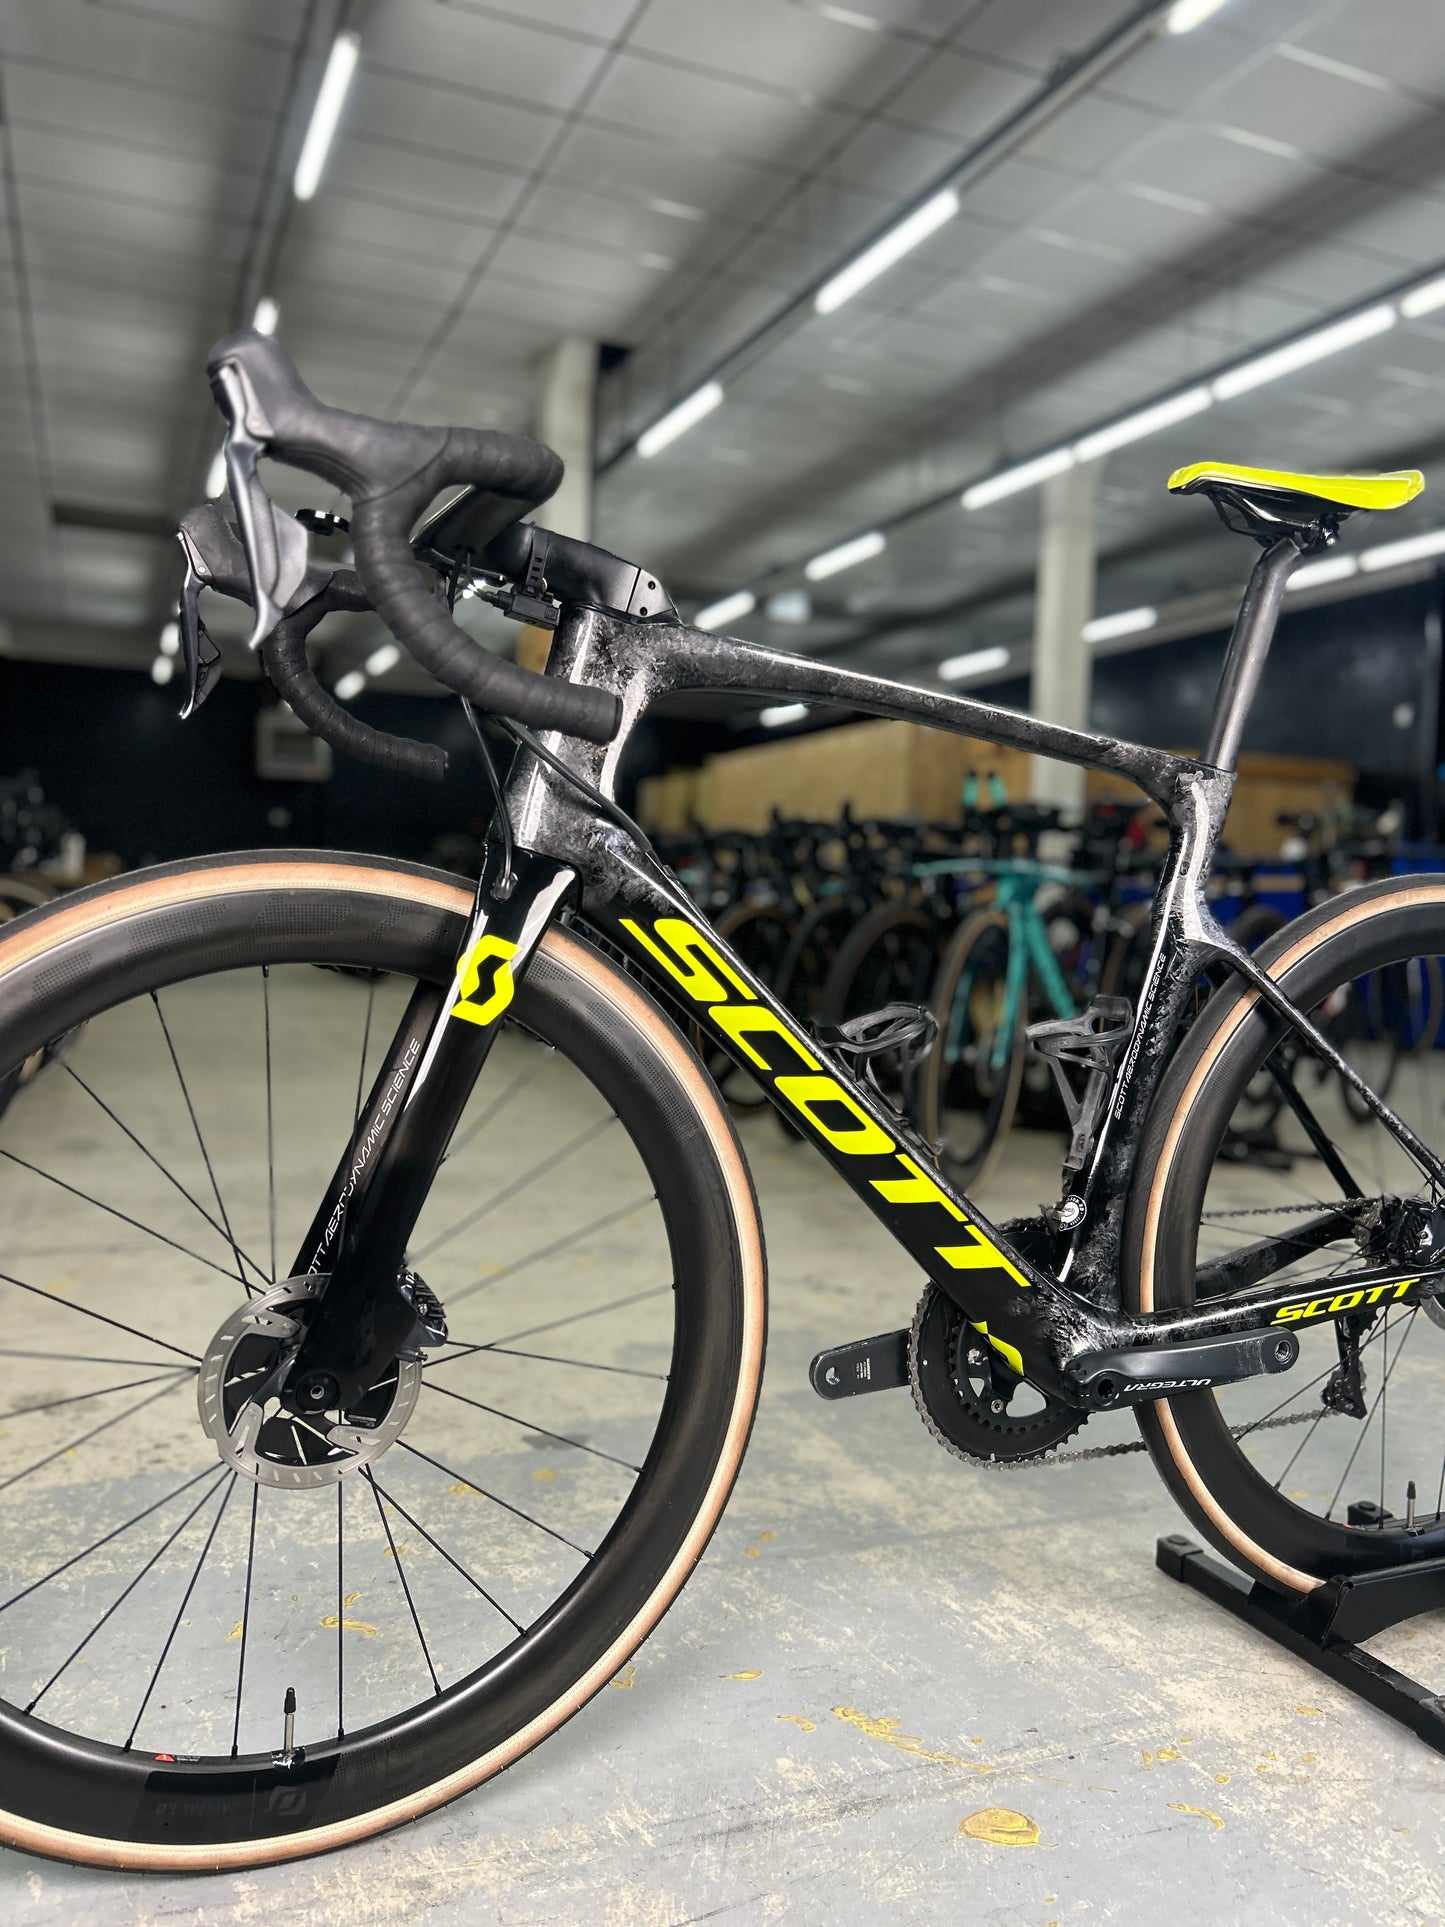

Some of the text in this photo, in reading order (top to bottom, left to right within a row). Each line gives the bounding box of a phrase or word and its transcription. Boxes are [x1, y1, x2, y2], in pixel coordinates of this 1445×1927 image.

[1114, 952, 1167, 1120] SCOTT AERODYNAMIC SCIENCE
[381, 1038, 421, 1116] SCIENCE
[618, 918, 1031, 1287] SCOTT
[1270, 1278, 1421, 1326] SCOTT
[1123, 1378, 1212, 1393] ULTEGRA
